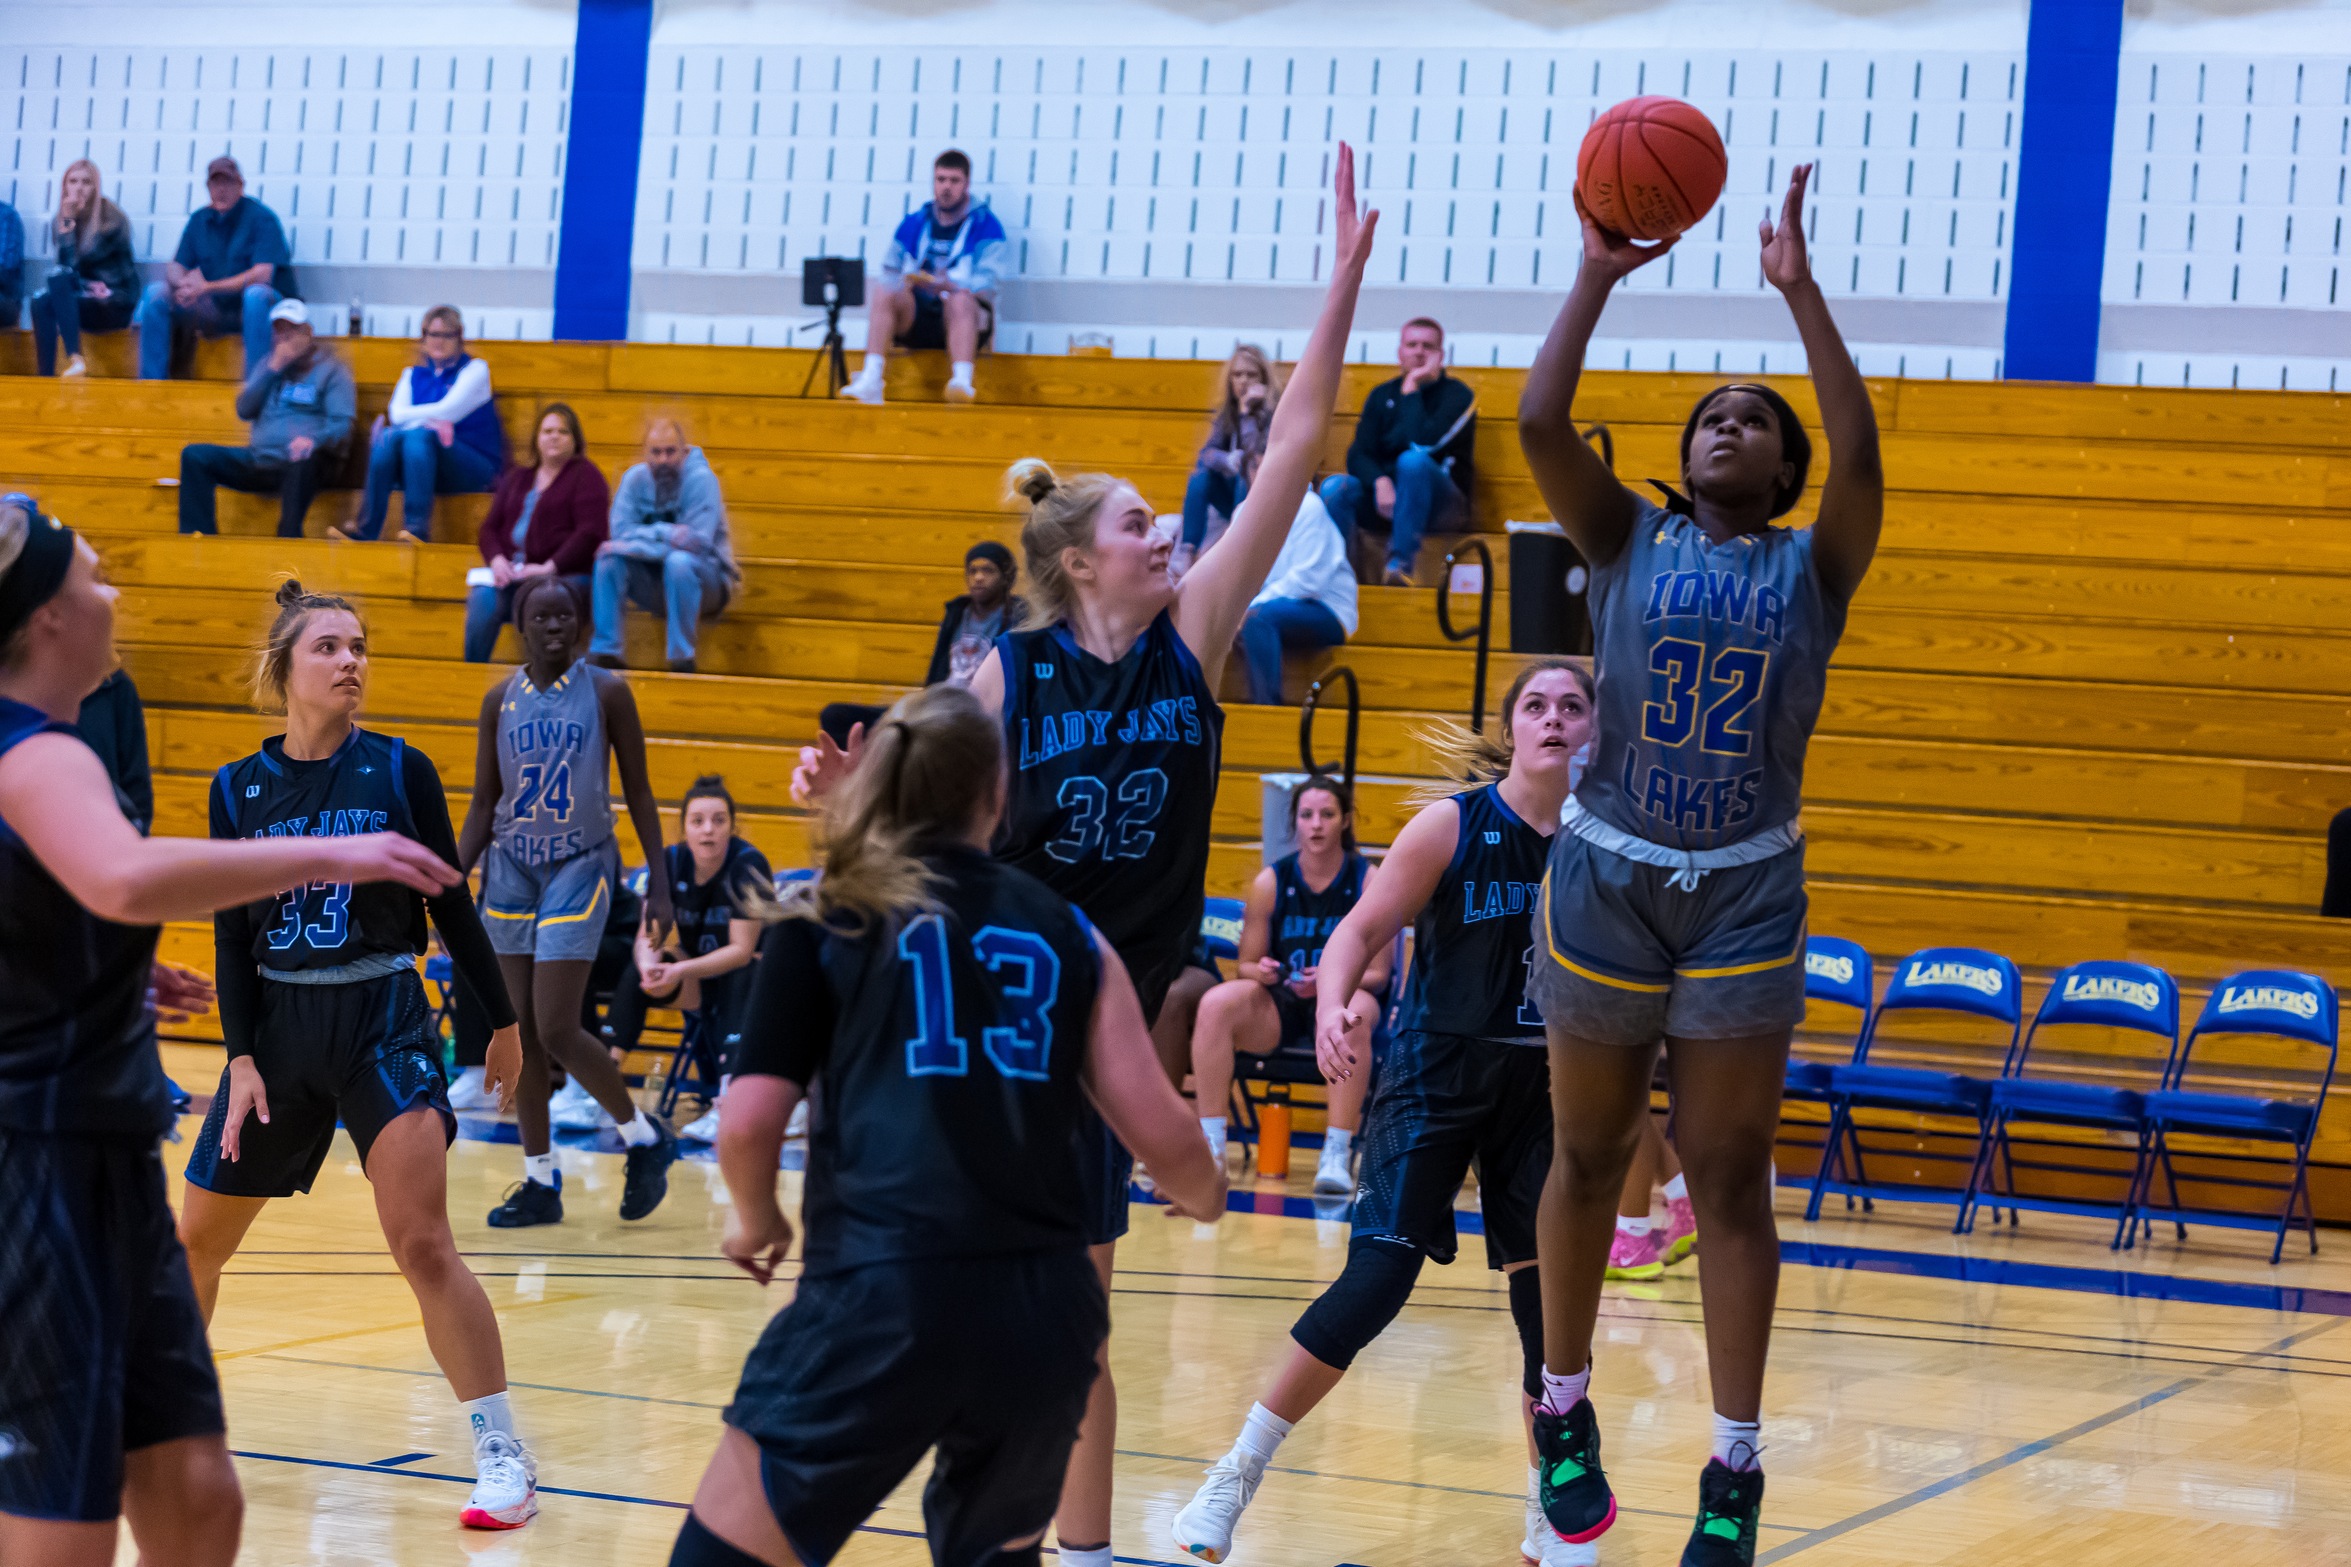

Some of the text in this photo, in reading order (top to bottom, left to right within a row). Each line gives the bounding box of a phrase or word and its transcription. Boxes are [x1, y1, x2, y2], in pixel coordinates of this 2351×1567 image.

[1643, 570, 1787, 646] IOWA
[1019, 695, 1202, 770] LADY JAYS
[1641, 635, 1770, 757] 32
[508, 717, 586, 763] IOWA
[512, 760, 575, 823] 24
[1044, 767, 1169, 864] 32
[1623, 742, 1765, 832] LAKES
[266, 876, 353, 949] 33
[897, 913, 1061, 1082] 13
[1905, 960, 2003, 997] LAKERS
[2063, 974, 2160, 1011] LAKERS
[2218, 986, 2319, 1019] LAKERS
